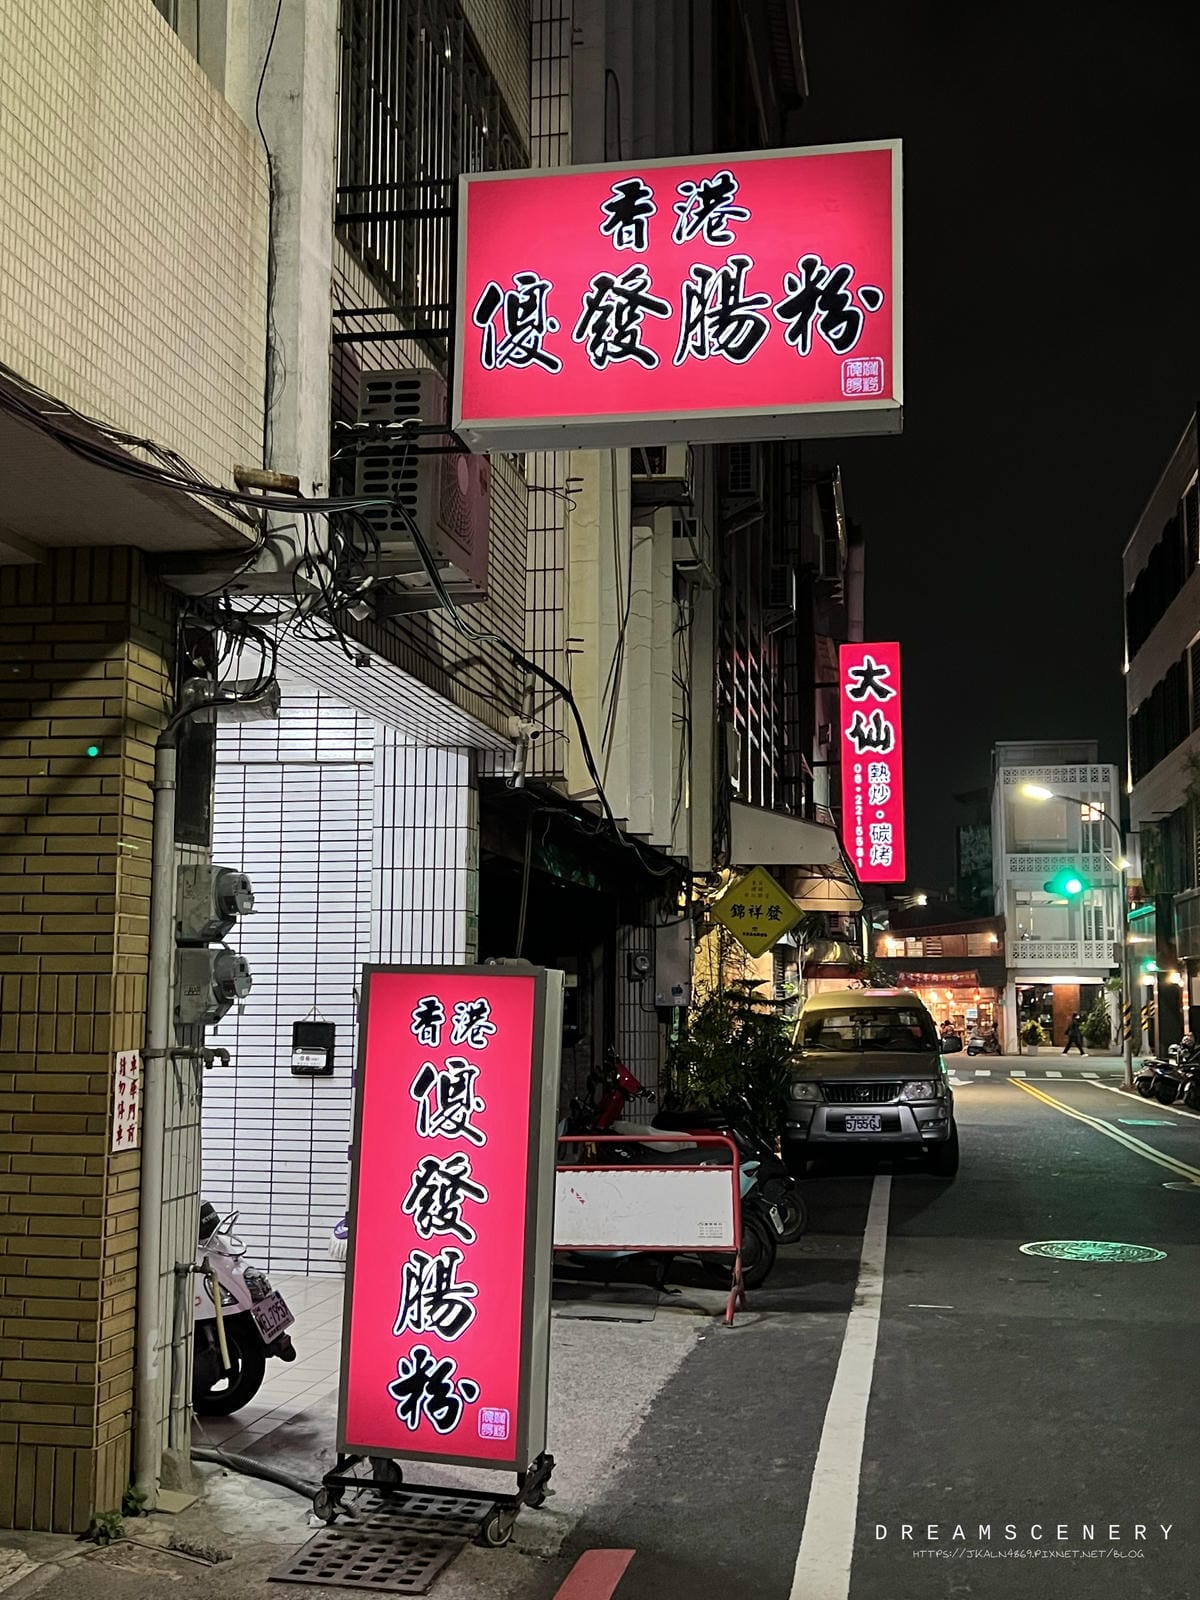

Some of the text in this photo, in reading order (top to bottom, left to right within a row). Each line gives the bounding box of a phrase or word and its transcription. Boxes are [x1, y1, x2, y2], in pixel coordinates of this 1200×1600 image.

[599, 169, 752, 253] 香港
[472, 252, 885, 374] 優發腸粉
[845, 654, 897, 754] 大仙
[730, 903, 783, 921] 錦祥發
[409, 994, 498, 1050] 香港
[116, 1056, 126, 1146] 請勿停車
[386, 1055, 490, 1435] 優發腸粉
